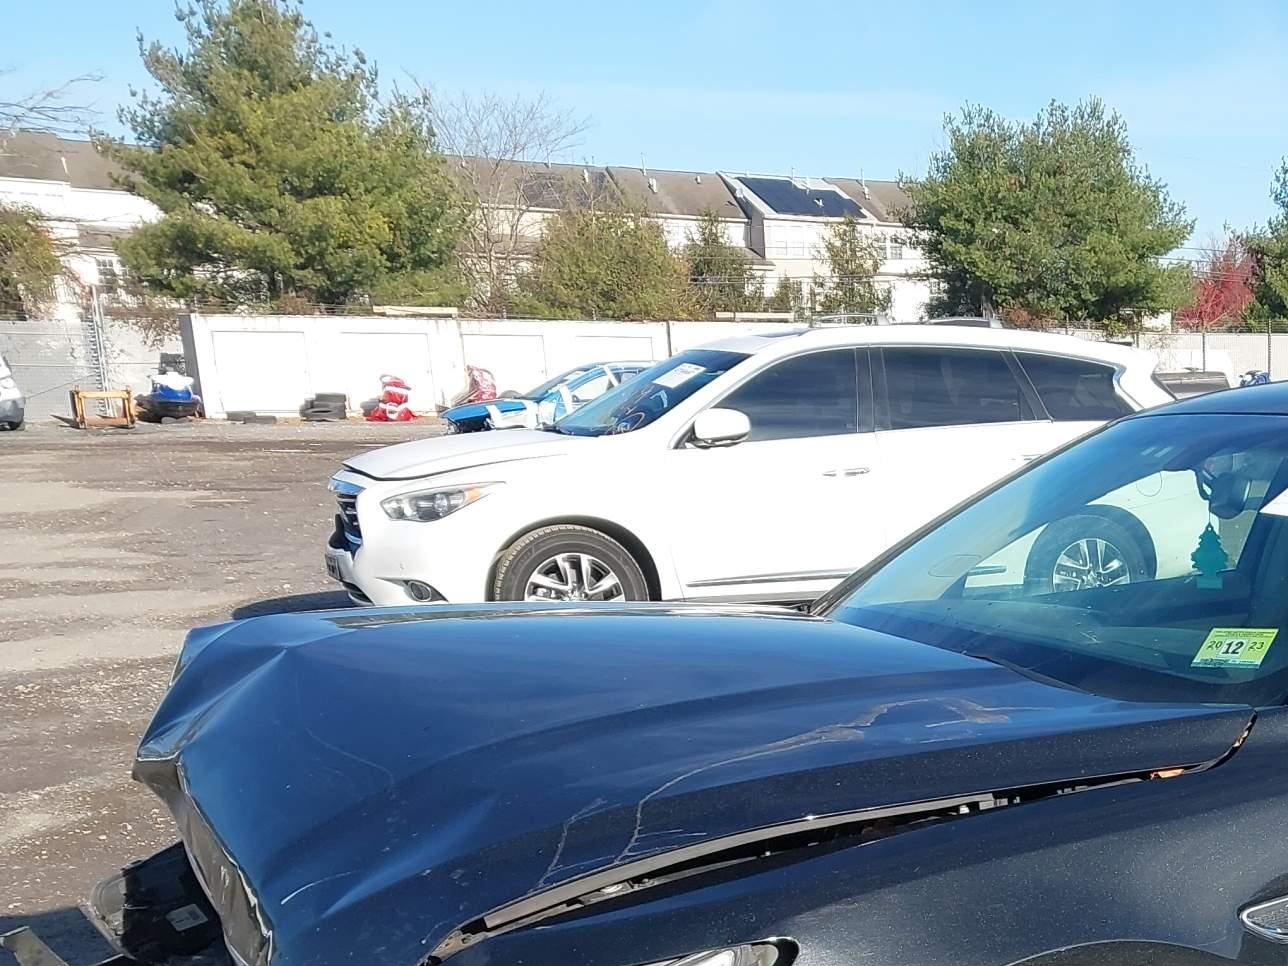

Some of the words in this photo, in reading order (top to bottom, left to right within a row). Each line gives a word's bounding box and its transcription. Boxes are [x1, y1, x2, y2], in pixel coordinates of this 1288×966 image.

[1206, 640, 1223, 650] 20
[1222, 641, 1244, 655] 12
[1248, 641, 1265, 651] 23
